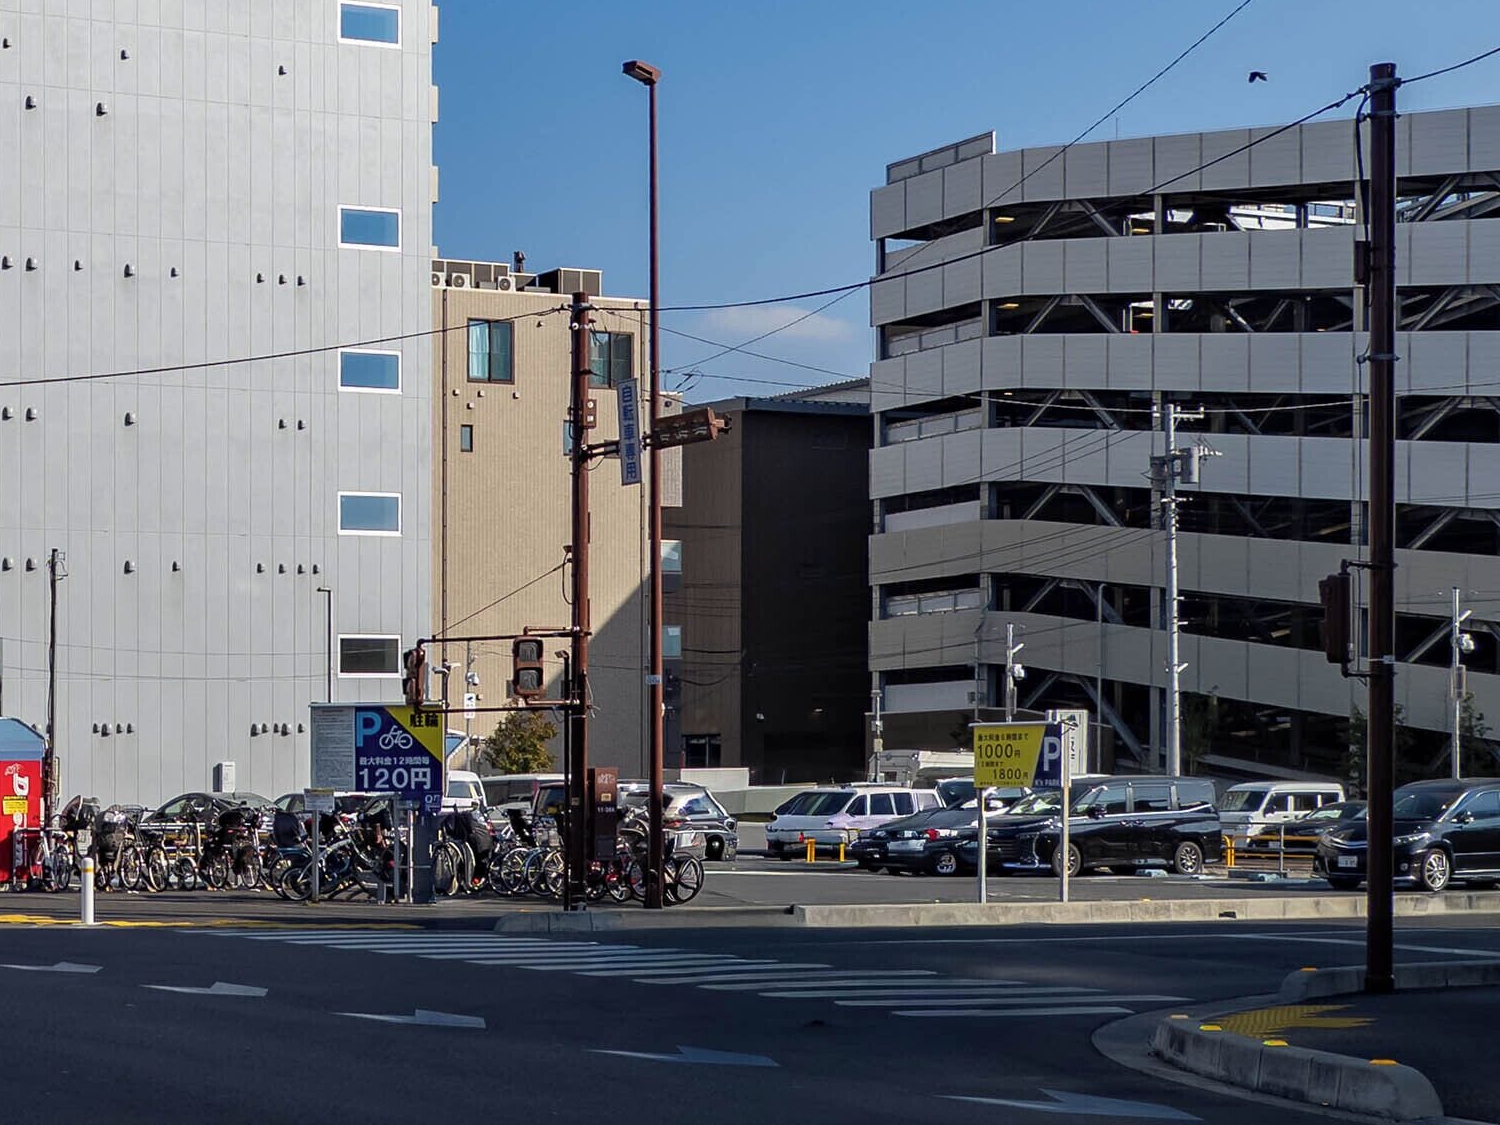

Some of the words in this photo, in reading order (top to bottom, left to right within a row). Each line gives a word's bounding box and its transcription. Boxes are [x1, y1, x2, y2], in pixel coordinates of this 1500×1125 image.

[622, 385, 638, 480] 自転車専用
[356, 711, 382, 747] P
[1043, 736, 1060, 771] P
[359, 767, 431, 789] 120円
